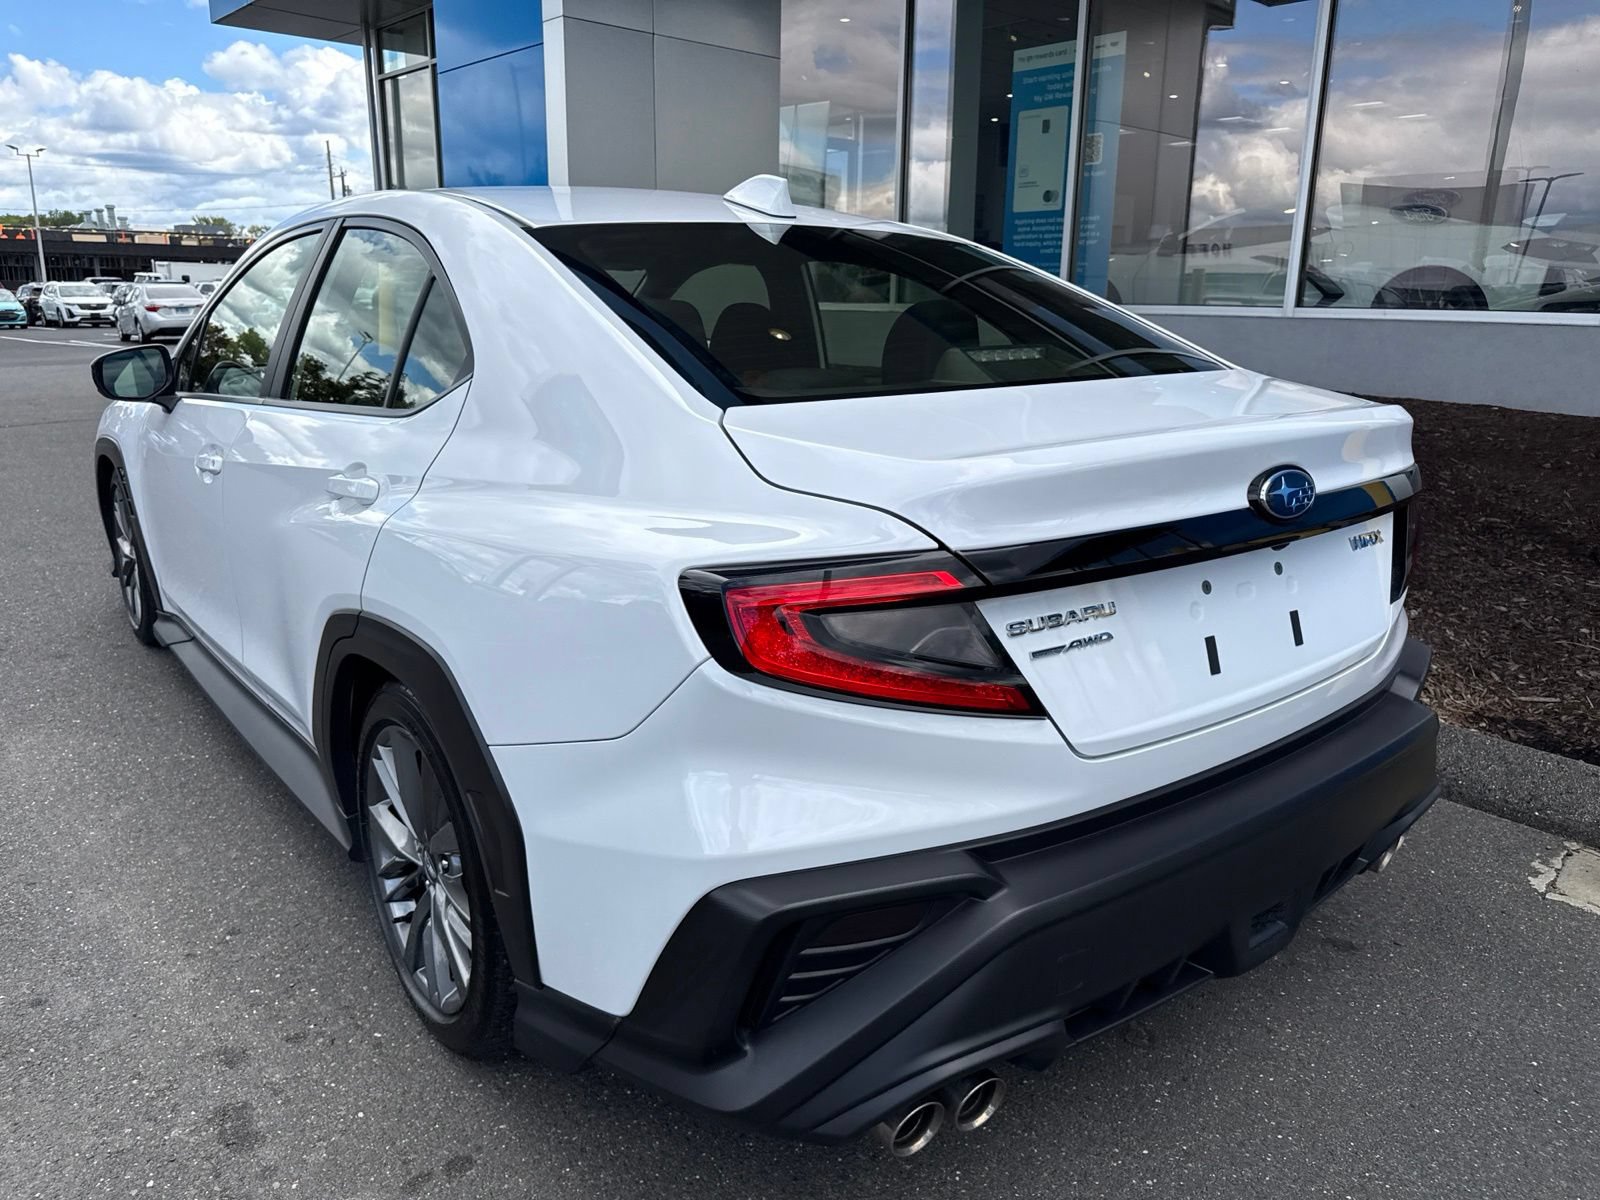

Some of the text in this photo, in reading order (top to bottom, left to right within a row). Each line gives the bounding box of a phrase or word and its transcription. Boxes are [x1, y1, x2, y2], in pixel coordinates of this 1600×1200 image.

[1348, 529, 1384, 552] WRX
[1006, 600, 1117, 638] SUBARU
[1062, 631, 1114, 654] AWD
